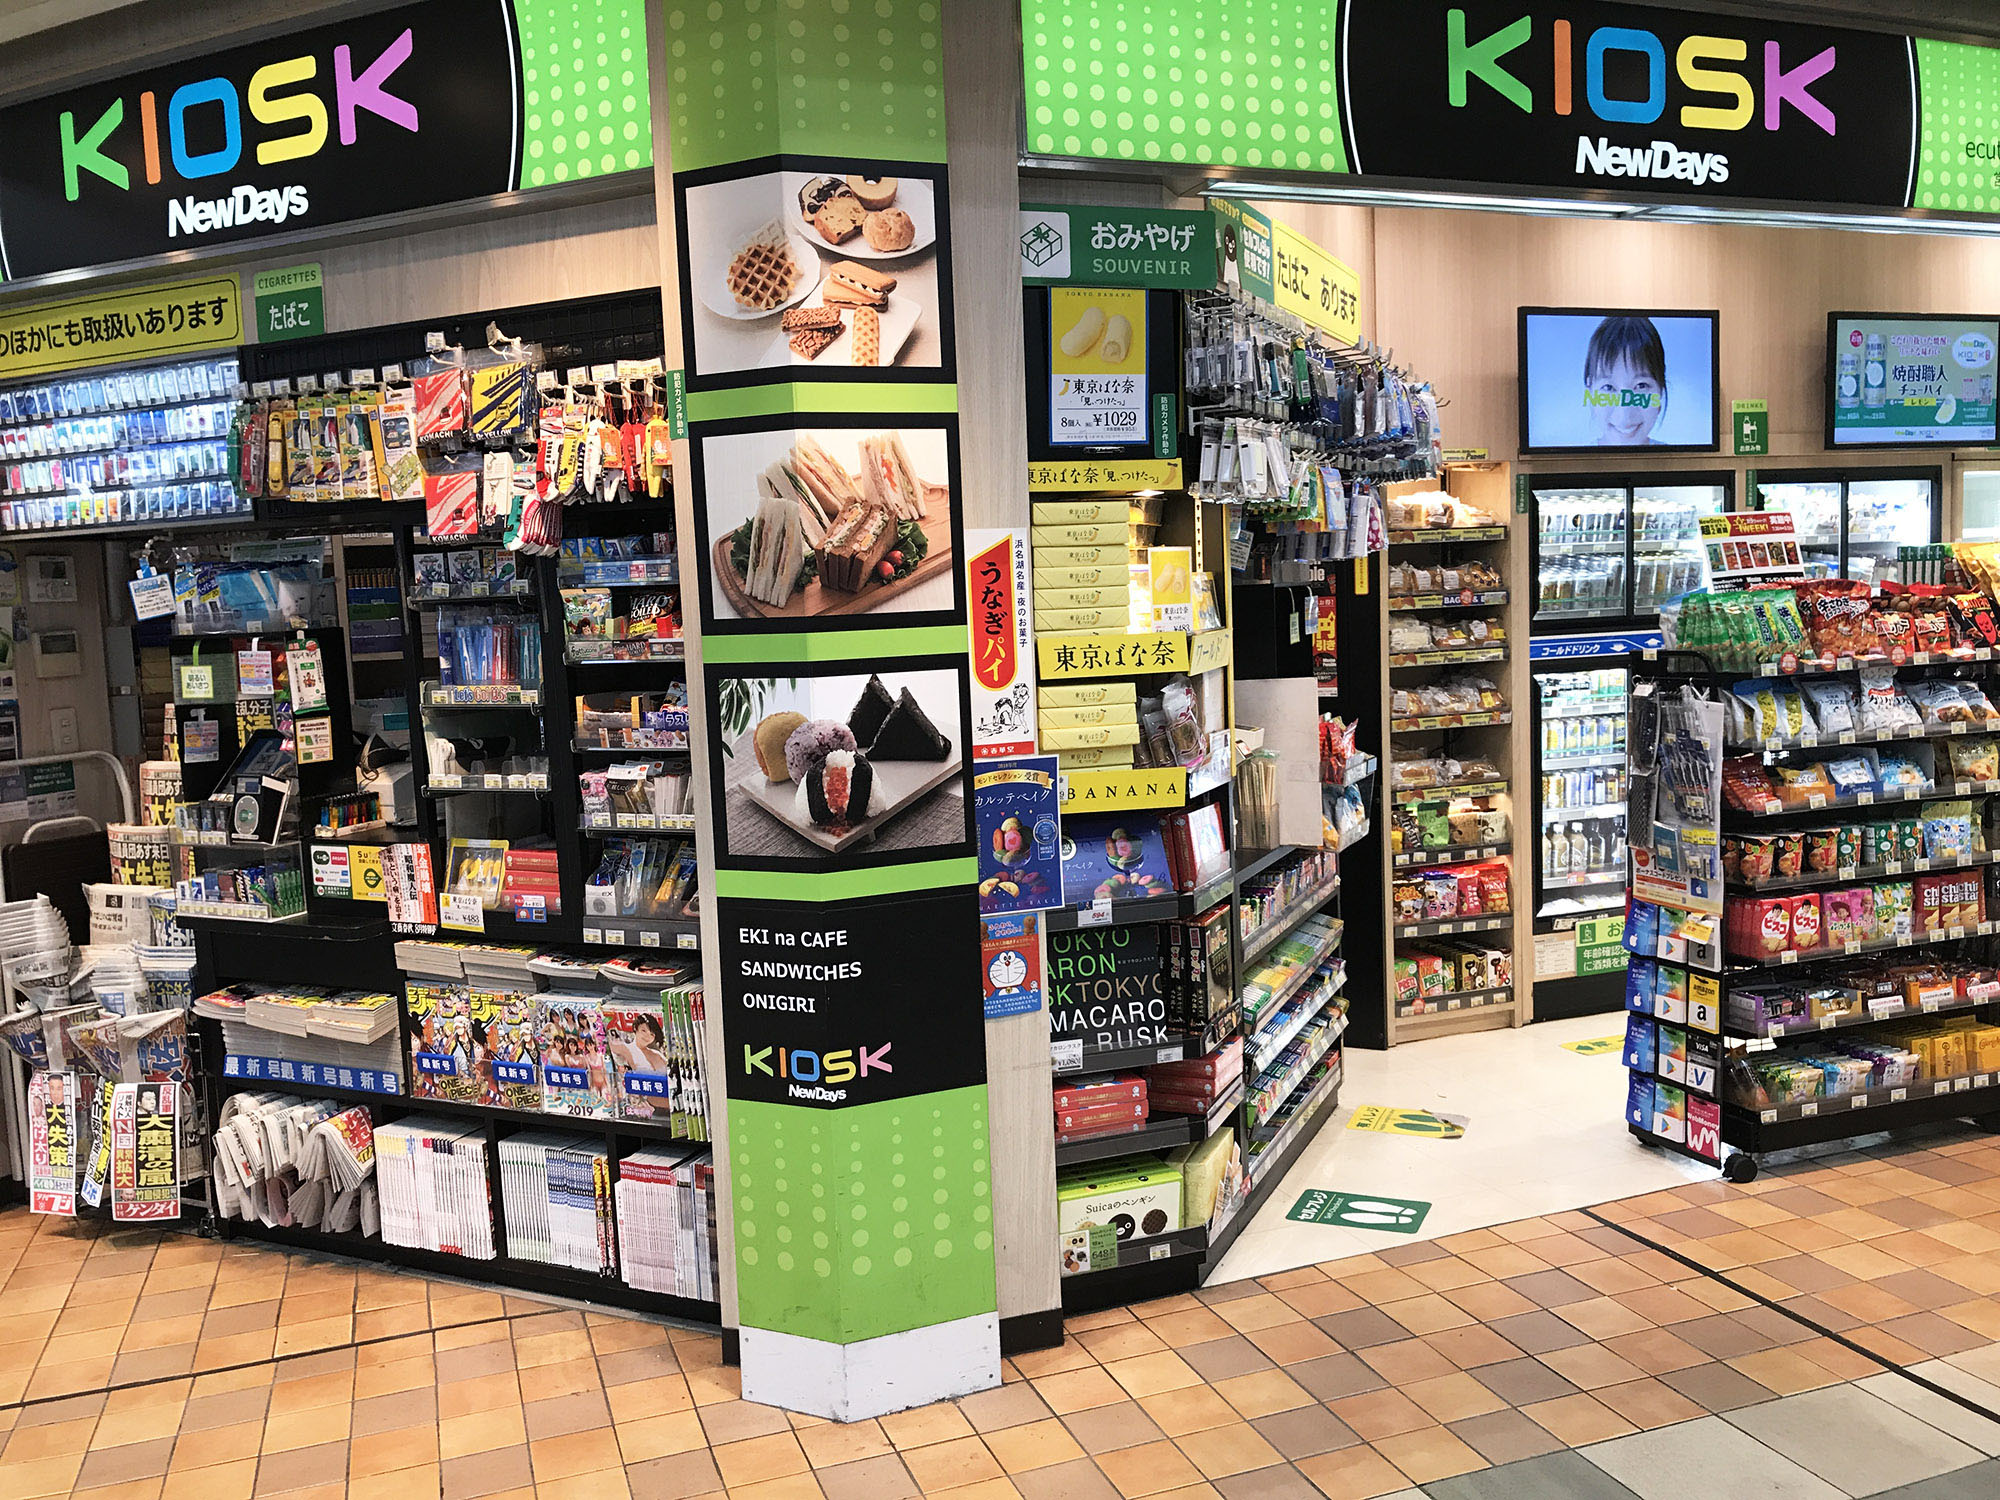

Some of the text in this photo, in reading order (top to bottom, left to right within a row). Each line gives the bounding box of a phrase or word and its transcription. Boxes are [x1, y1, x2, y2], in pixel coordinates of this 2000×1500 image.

[1447, 8, 1836, 137] KIOSK
[59, 27, 419, 202] KIOSK
[1575, 135, 1730, 186] NewDays
[168, 184, 310, 238] NewDays
[1090, 221, 1196, 253] おみやげ
[1092, 257, 1192, 276] SOUVENIR
[257, 270, 317, 289] CIGARETTES
[1277, 247, 1357, 325] たばこ あります
[268, 301, 311, 332] たばこ
[0, 296, 228, 357] のほかにも取扱いあります
[1893, 364, 1949, 382] 焼酎職人
[1073, 376, 1135, 394] 東京ばな奈
[1899, 384, 1942, 396] チューハイ
[673, 372, 685, 436] 防犯カメラ作動中
[1583, 389, 1661, 409] NewDays
[1061, 411, 1137, 427] 8個入 ¥1029
[1160, 396, 1169, 455] 防犯カメラ作動中
[419, 430, 454, 444] KOMACHI
[432, 534, 468, 546] KOMACHI
[1014, 539, 1028, 648] 浜名湖名産・夜のお菓子
[1164, 606, 1189, 615] 東京ばな奈
[979, 561, 1008, 683] うなぎパイ
[1053, 639, 1176, 673] 東京ばな奈
[1541, 644, 1601, 656] コールドドリンク
[977, 771, 1039, 786] モンドセレクション 受賞
[975, 789, 1050, 809] カルッテベイク
[1068, 782, 1178, 800] BANANA
[1764, 917, 1787, 934] ビスコ
[1795, 914, 1818, 929] ビスコ
[739, 928, 848, 948] EKI na CAFE
[741, 961, 862, 981] SANDWICHES
[1693, 984, 1715, 995] amazon
[743, 993, 816, 1013] ONIGIRI
[1049, 999, 1166, 1034] MACARO
[1697, 1005, 1706, 1022] a
[1096, 1025, 1170, 1052] RUSK
[1695, 1042, 1709, 1052] VISA
[422, 1058, 451, 1071] 最新号
[744, 1041, 893, 1084] KIOSK
[224, 1056, 398, 1093] 最新号 最新号 最新号
[498, 1067, 528, 1080] 最新号
[551, 1071, 582, 1085] 最新号
[1694, 1068, 1707, 1086] V
[440, 1078, 460, 1090] ONE
[506, 1086, 527, 1098] ONE
[631, 1079, 664, 1094] 最新号
[788, 1084, 847, 1102] NewDays
[545, 1092, 613, 1114] ミスマガジン
[567, 1104, 593, 1116] 2019
[1687, 1113, 1719, 1131] WebMoney
[33, 1116, 48, 1165] 焼け太り
[47, 1105, 68, 1166] 大失策
[137, 1114, 175, 1186] 大粛清の嵐
[125, 1201, 177, 1218] ゲンダイ
[1086, 1195, 1157, 1214] Suicaのペンギン
[1297, 1191, 1328, 1220] セルフレジ
[1092, 1249, 1109, 1261] 648
